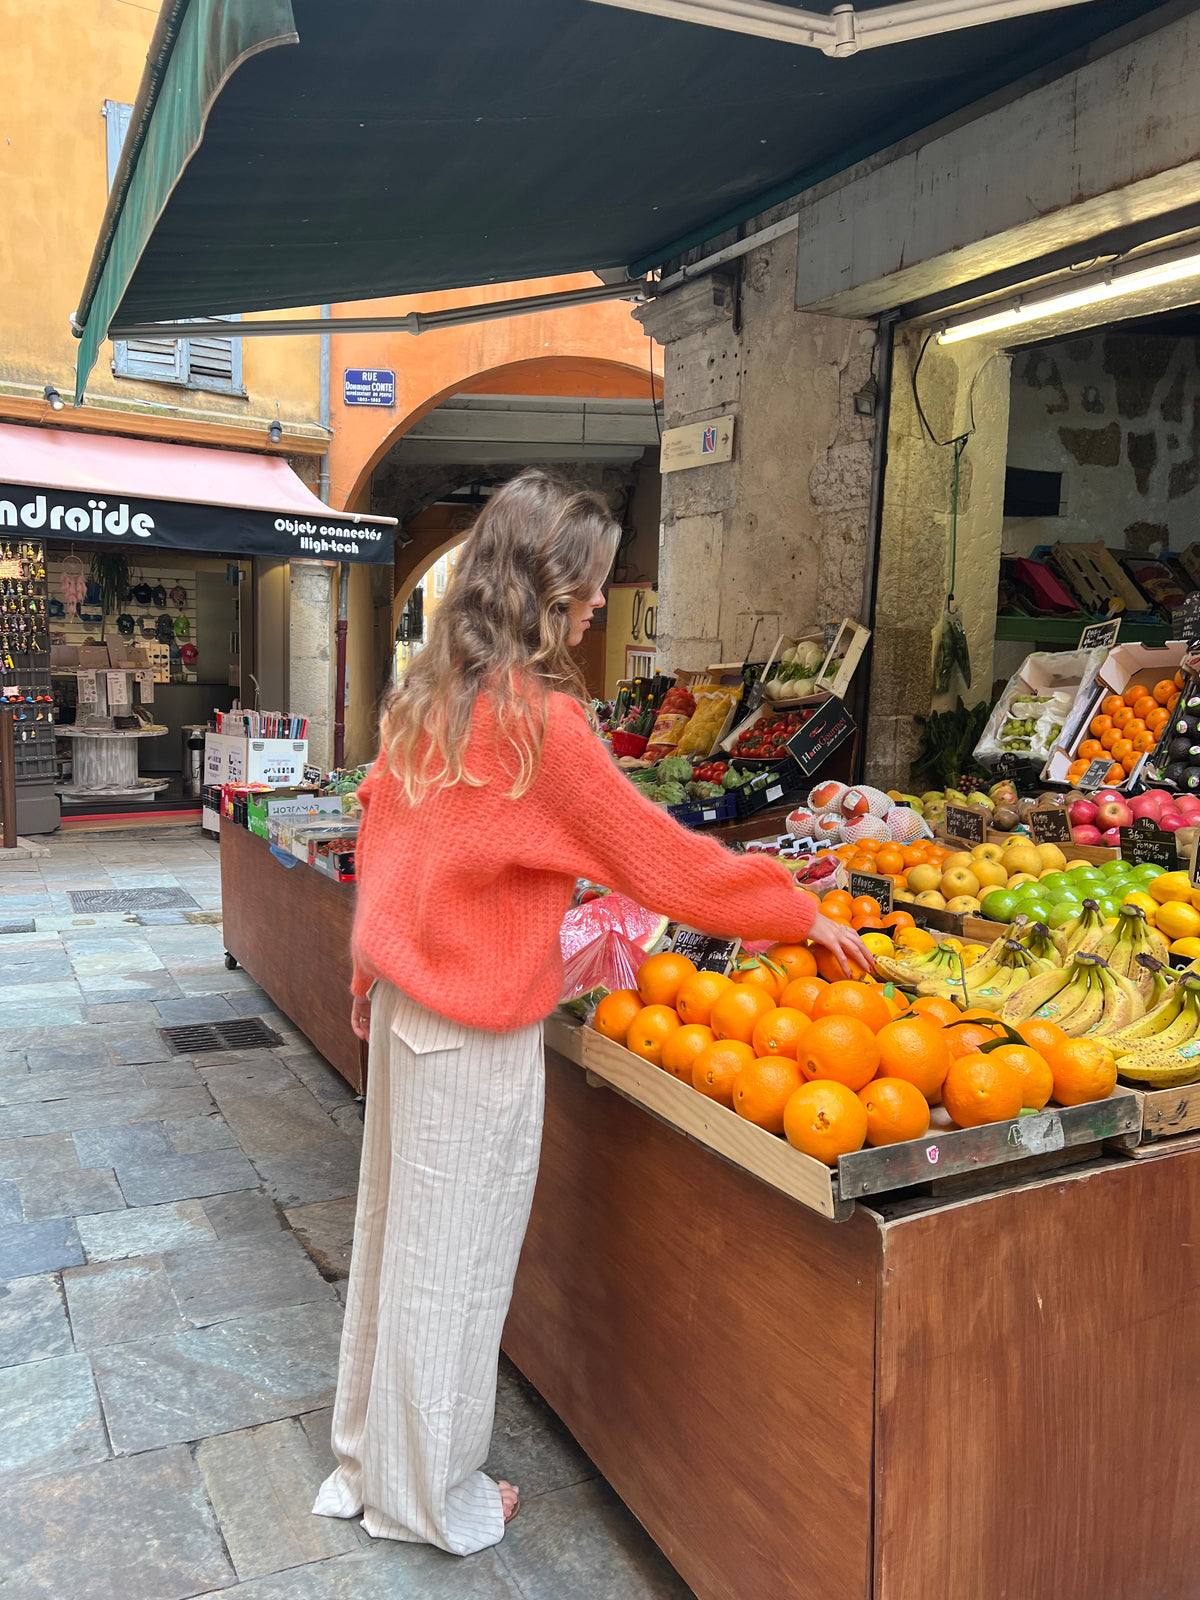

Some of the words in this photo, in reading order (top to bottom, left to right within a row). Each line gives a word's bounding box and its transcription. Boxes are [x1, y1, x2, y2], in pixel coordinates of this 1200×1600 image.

[362, 372, 377, 381] RUE
[372, 383, 392, 391] CONTE
[0, 495, 155, 537] ndroïde
[274, 518, 317, 536] Objets
[319, 525, 382, 541] connectés
[300, 536, 359, 553] High-tech
